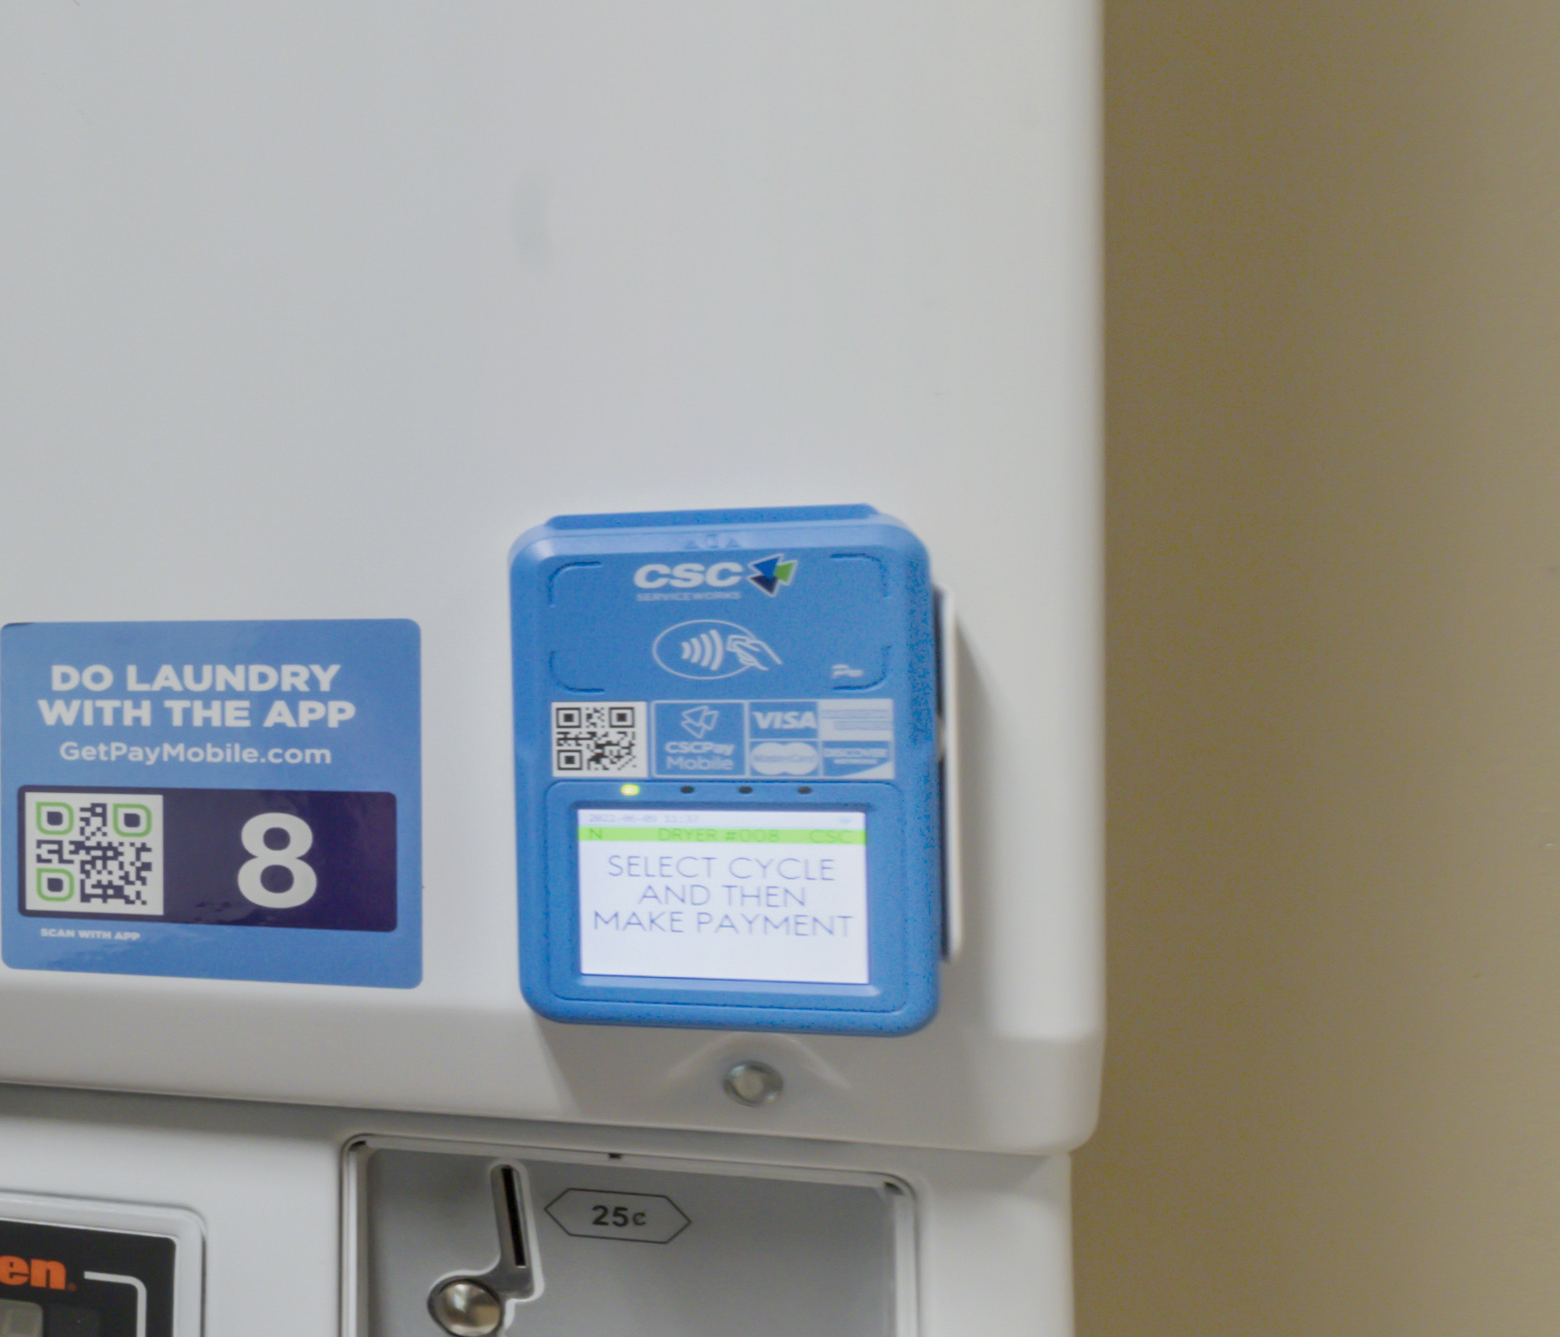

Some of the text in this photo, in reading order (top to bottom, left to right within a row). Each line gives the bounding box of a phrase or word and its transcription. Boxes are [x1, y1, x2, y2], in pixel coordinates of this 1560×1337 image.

[633, 562, 744, 589] CSC
[636, 591, 741, 601] SERVICEWORKS
[51, 664, 342, 692] DO LAUNDRY
[38, 699, 357, 728] WITH THE APP
[751, 711, 818, 730] VISA
[59, 741, 332, 765] GetPayMobile.com
[665, 740, 735, 758] CSCPay
[665, 755, 734, 772] Mobile
[657, 827, 853, 844] DRYER #008 CSC
[237, 811, 318, 909] 8
[608, 855, 836, 882] SELECT CYCLE
[637, 884, 806, 908] AND THEN
[593, 910, 854, 937] MAKE PAYMENT
[592, 1203, 648, 1229] 25¢
